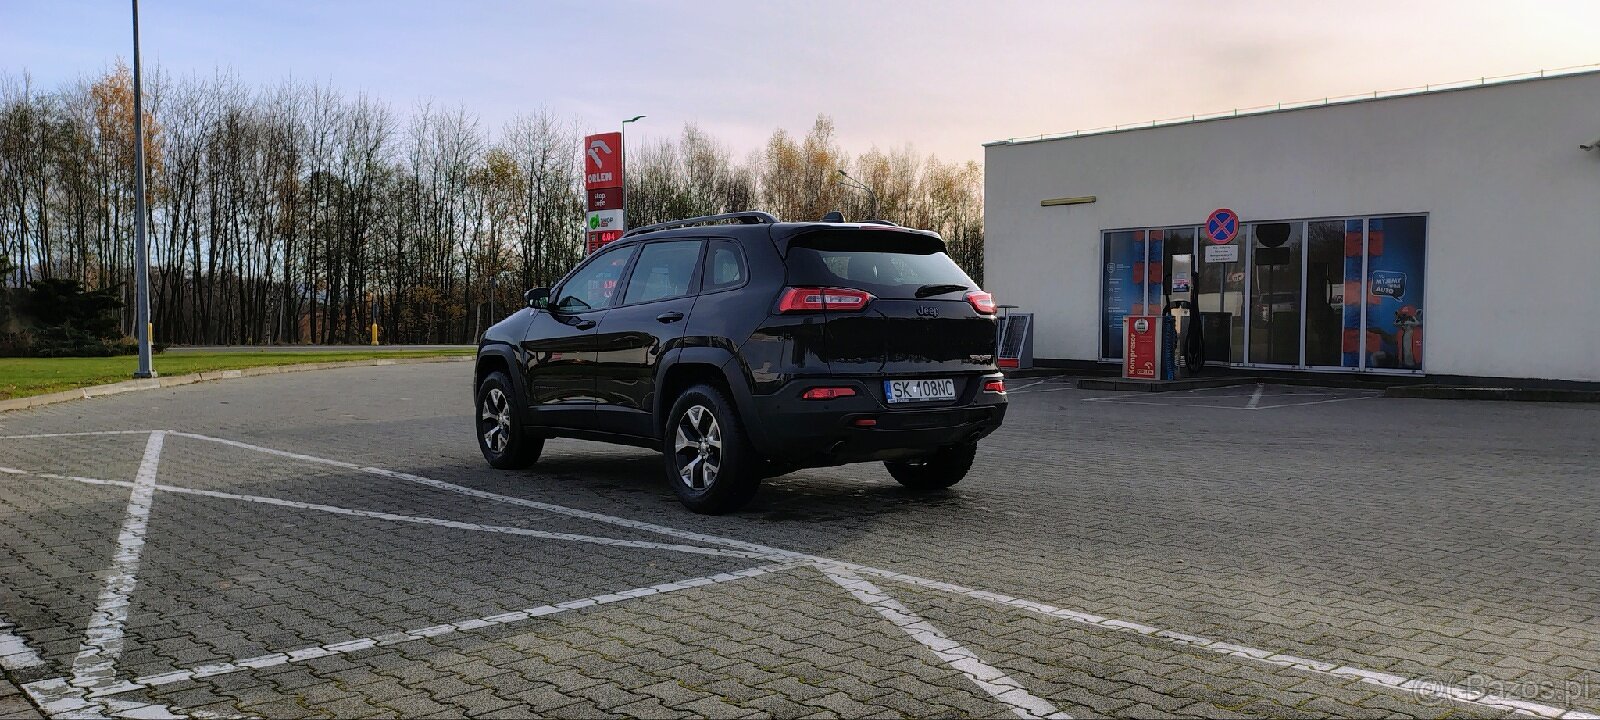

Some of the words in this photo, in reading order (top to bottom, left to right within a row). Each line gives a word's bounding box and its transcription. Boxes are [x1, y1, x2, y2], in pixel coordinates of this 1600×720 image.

[587, 172, 612, 183] ORLEN
[1375, 286, 1394, 294] AUTO
[917, 305, 939, 317] Jeep
[1129, 332, 1138, 374] Kompresor
[893, 381, 912, 398] SK
[916, 380, 953, 397] 108NC
